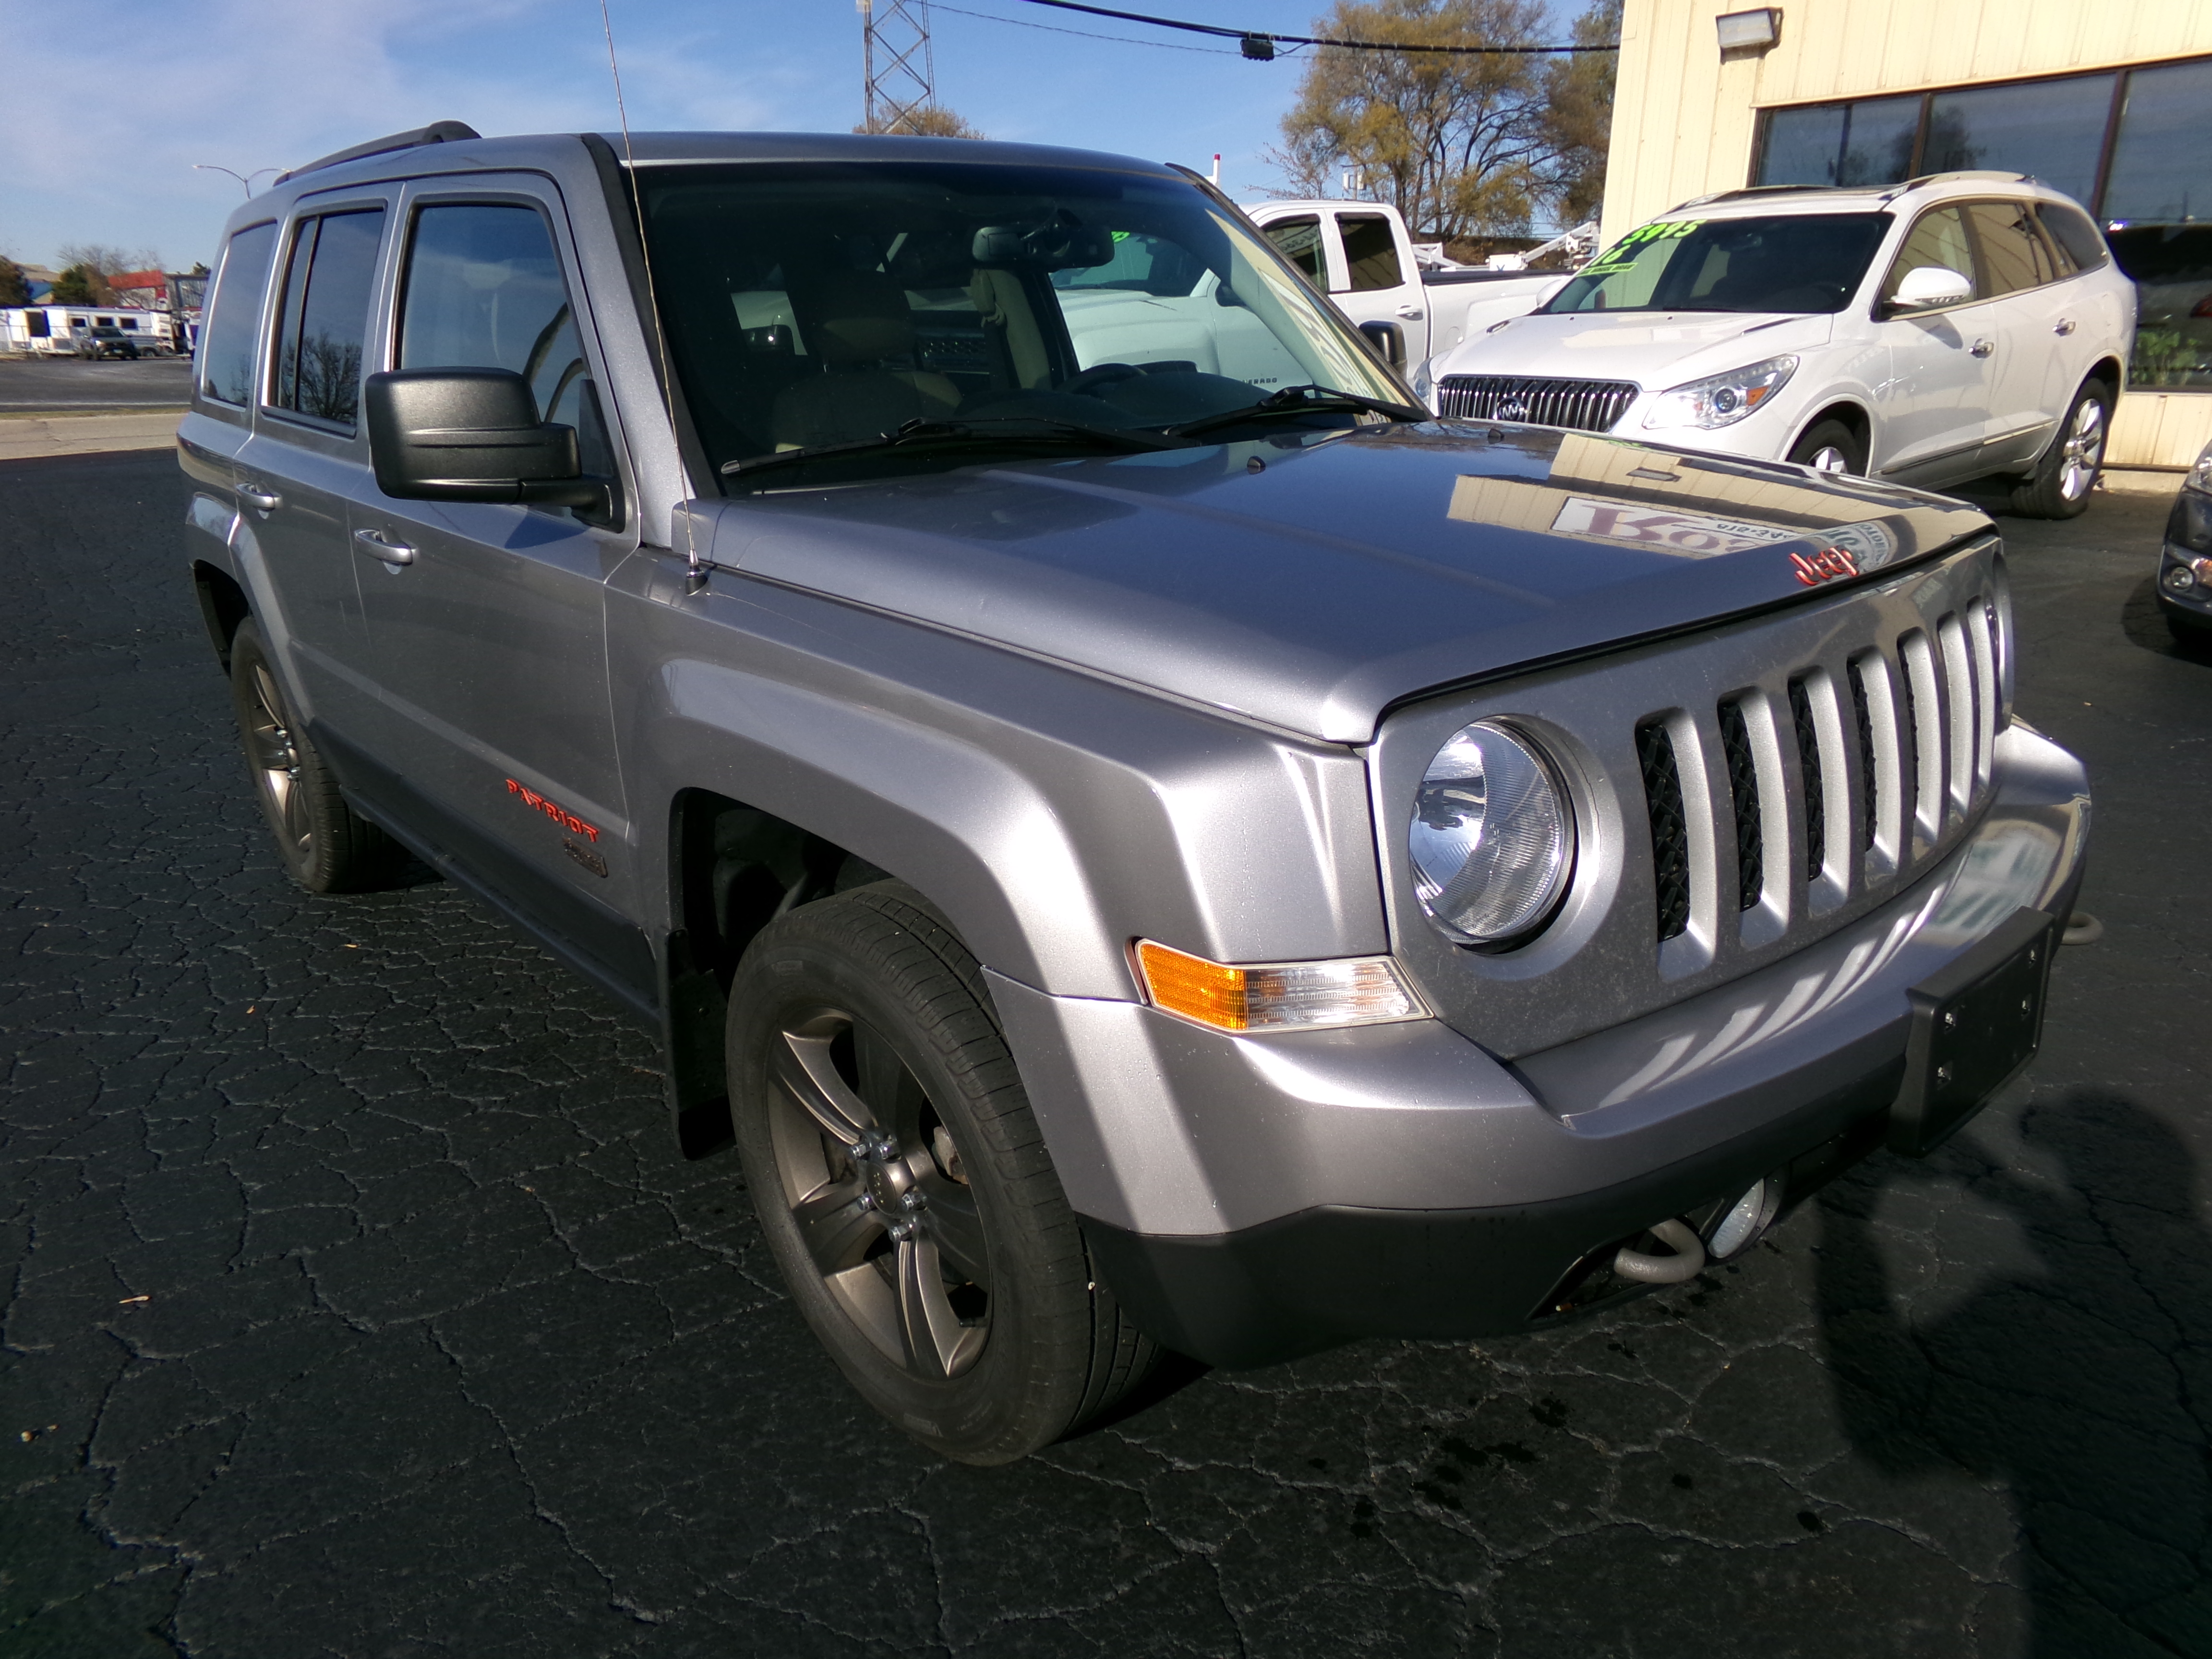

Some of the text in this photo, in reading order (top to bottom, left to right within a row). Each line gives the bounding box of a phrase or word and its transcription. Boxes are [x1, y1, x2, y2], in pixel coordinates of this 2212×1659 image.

[1590, 244, 1631, 266] 16
[1242, 376, 1278, 385] ERADO
[1789, 545, 1859, 586] Jeep
[505, 778, 600, 843] PATRIOT
